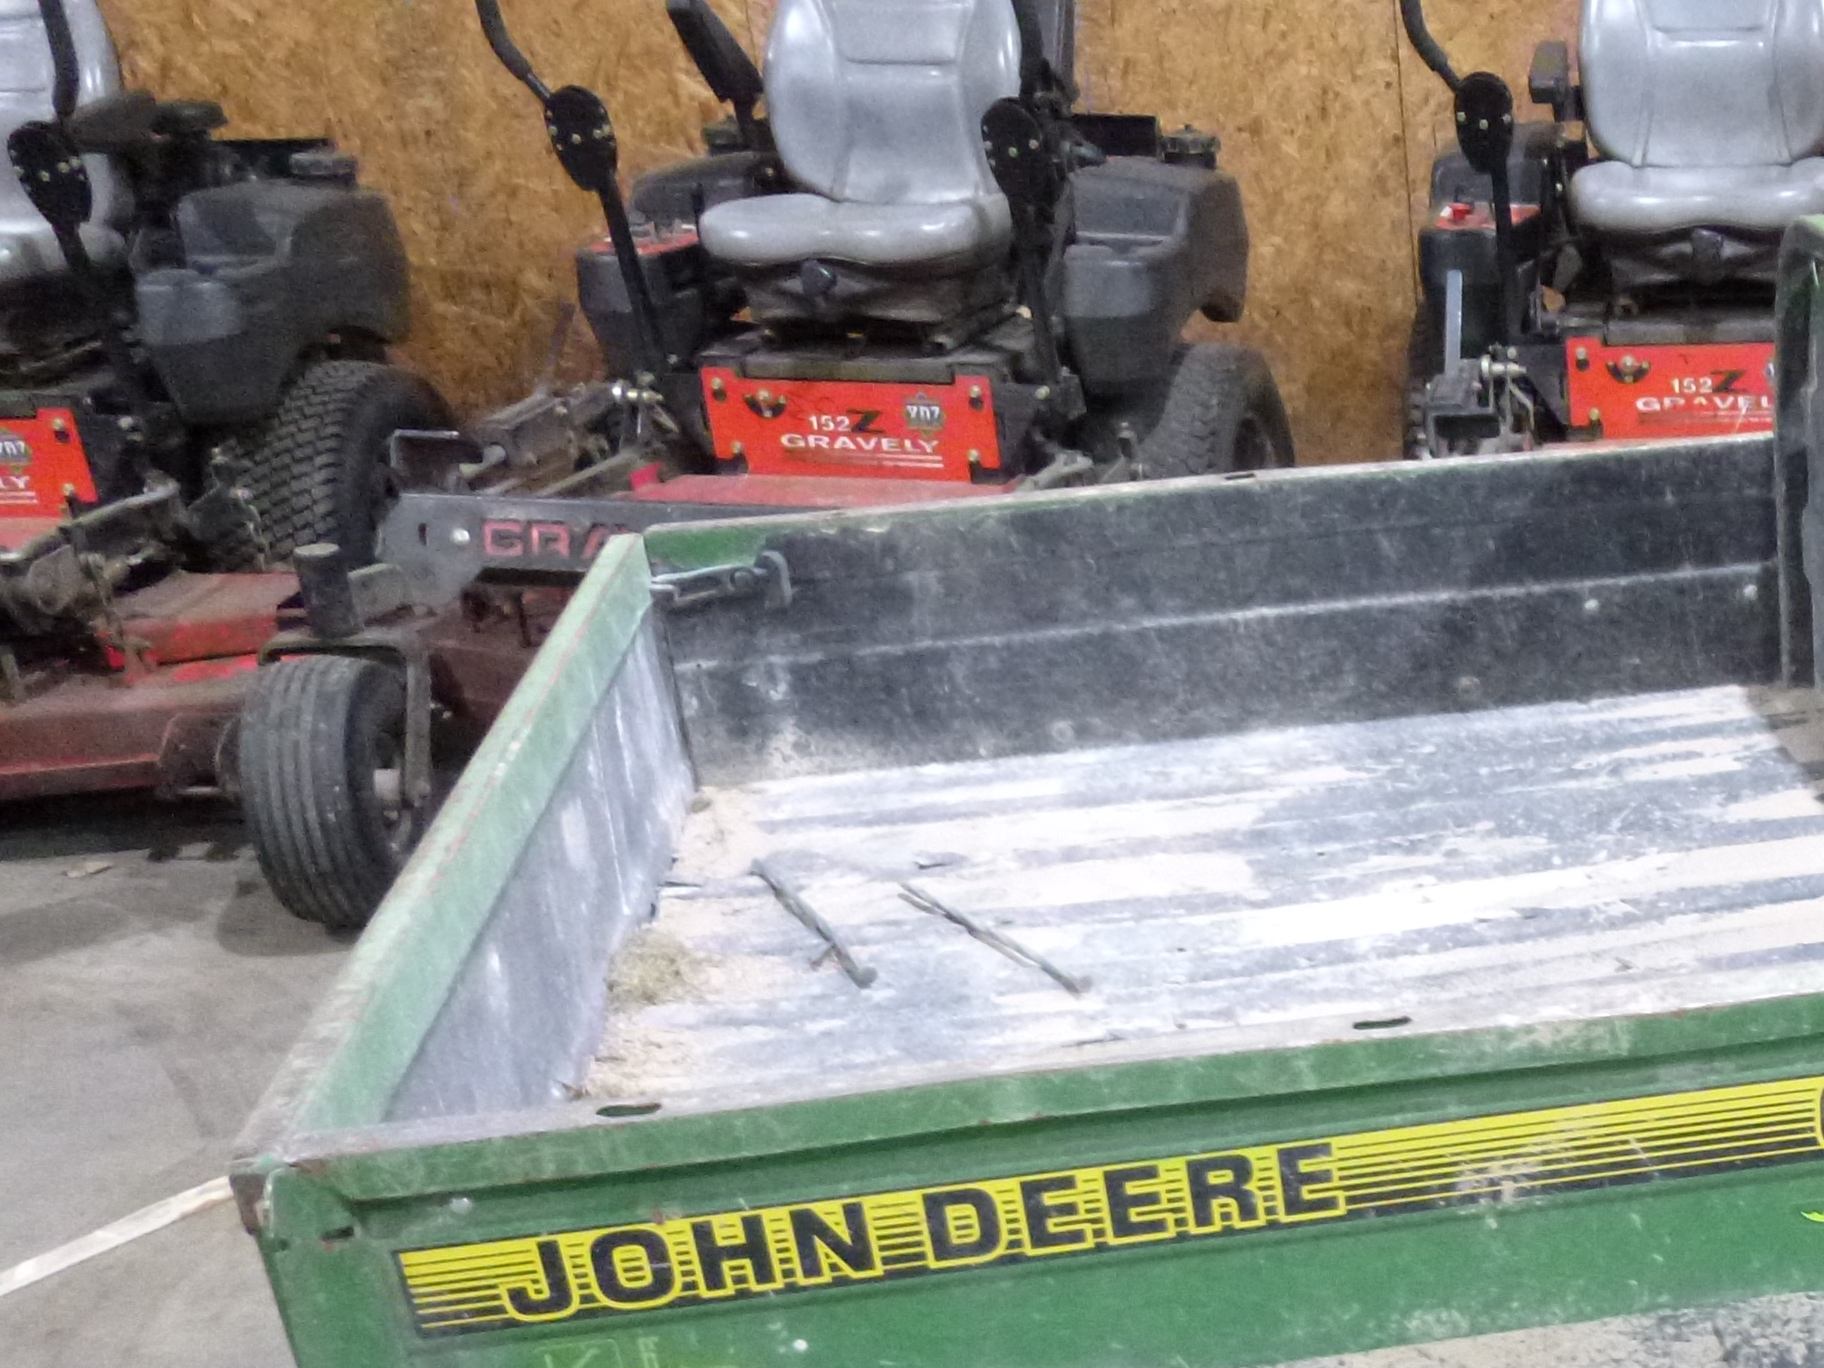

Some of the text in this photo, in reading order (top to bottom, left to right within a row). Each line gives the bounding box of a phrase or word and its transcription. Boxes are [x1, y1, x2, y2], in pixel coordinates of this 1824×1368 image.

[808, 408, 886, 434] 152Z
[780, 433, 939, 454] GRAVELY
[502, 1142, 1345, 1321] JOHN DEERE
